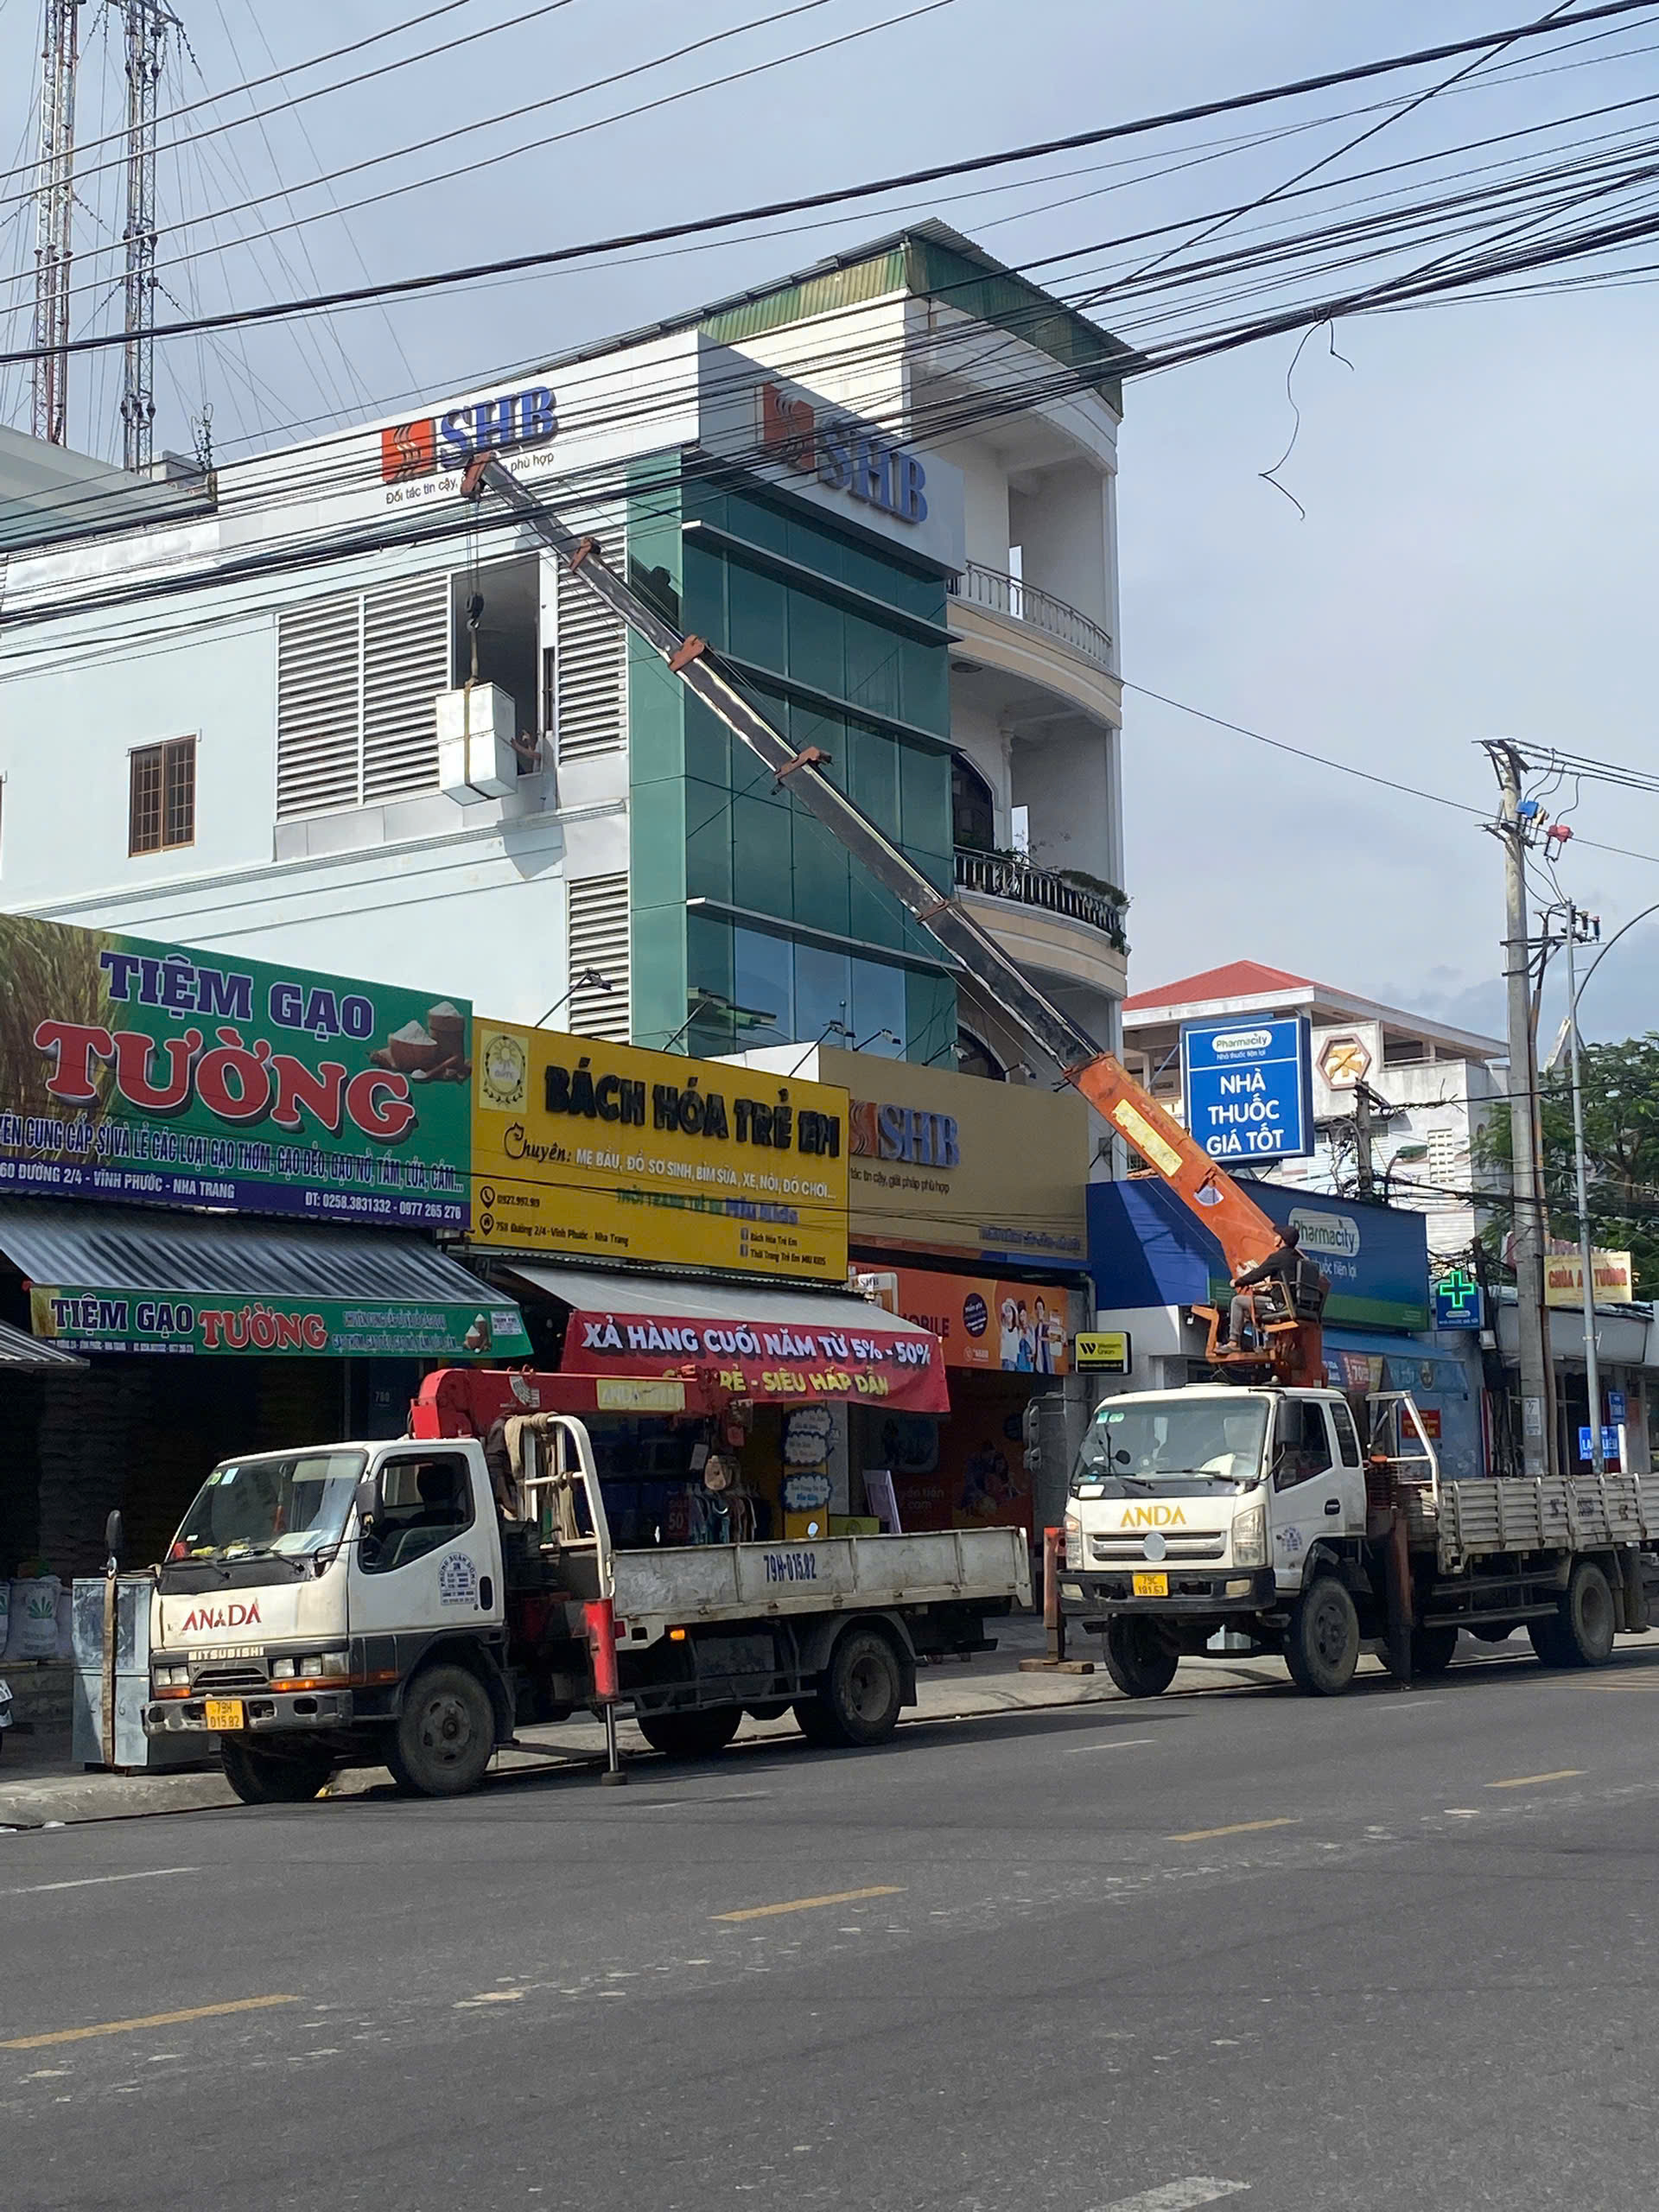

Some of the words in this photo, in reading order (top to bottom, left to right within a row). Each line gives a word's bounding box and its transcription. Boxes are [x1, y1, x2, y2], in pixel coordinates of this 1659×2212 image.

[440, 386, 558, 465] SHB
[817, 417, 928, 524] SHB
[99, 953, 253, 1021] TIỆM
[268, 982, 374, 1042] GẠO
[33, 1020, 416, 1138] TƯỜNG
[1220, 1067, 1266, 1095] NHÀ
[545, 1057, 646, 1126] BÁCH
[652, 1077, 729, 1140] HÓA
[734, 1088, 793, 1149] TRẺ
[798, 1109, 841, 1158] EM
[1208, 1093, 1280, 1125] THUỐC
[25, 1117, 64, 1151] CUNG
[877, 1103, 960, 1168] SHB
[1206, 1125, 1242, 1155] GIÁ
[1246, 1122, 1284, 1151] TỐT
[63, 1167, 82, 1185] 2/4
[173, 1179, 197, 1196] NHA
[199, 1180, 235, 1198] TRANG
[399, 1201, 423, 1216] 0977
[50, 1293, 128, 1336] TIỆM
[136, 1300, 194, 1338] GẠO
[198, 1303, 328, 1350] TƯỜNG
[582, 1315, 622, 1350] XẢ
[627, 1319, 699, 1352] HÀNG
[703, 1324, 761, 1354] CUỐI
[763, 1328, 817, 1357] NĂM
[818, 1332, 846, 1359] TỪ
[855, 1339, 883, 1360] 5%
[895, 1342, 931, 1365] 50%
[720, 1363, 747, 1391] RẺ
[762, 1367, 806, 1392] SIÊU
[811, 1366, 852, 1392] HẤP
[855, 1366, 888, 1395] DẪN
[1121, 1505, 1186, 1528] ANDA
[188, 1646, 264, 1661] MITSUBISHI
